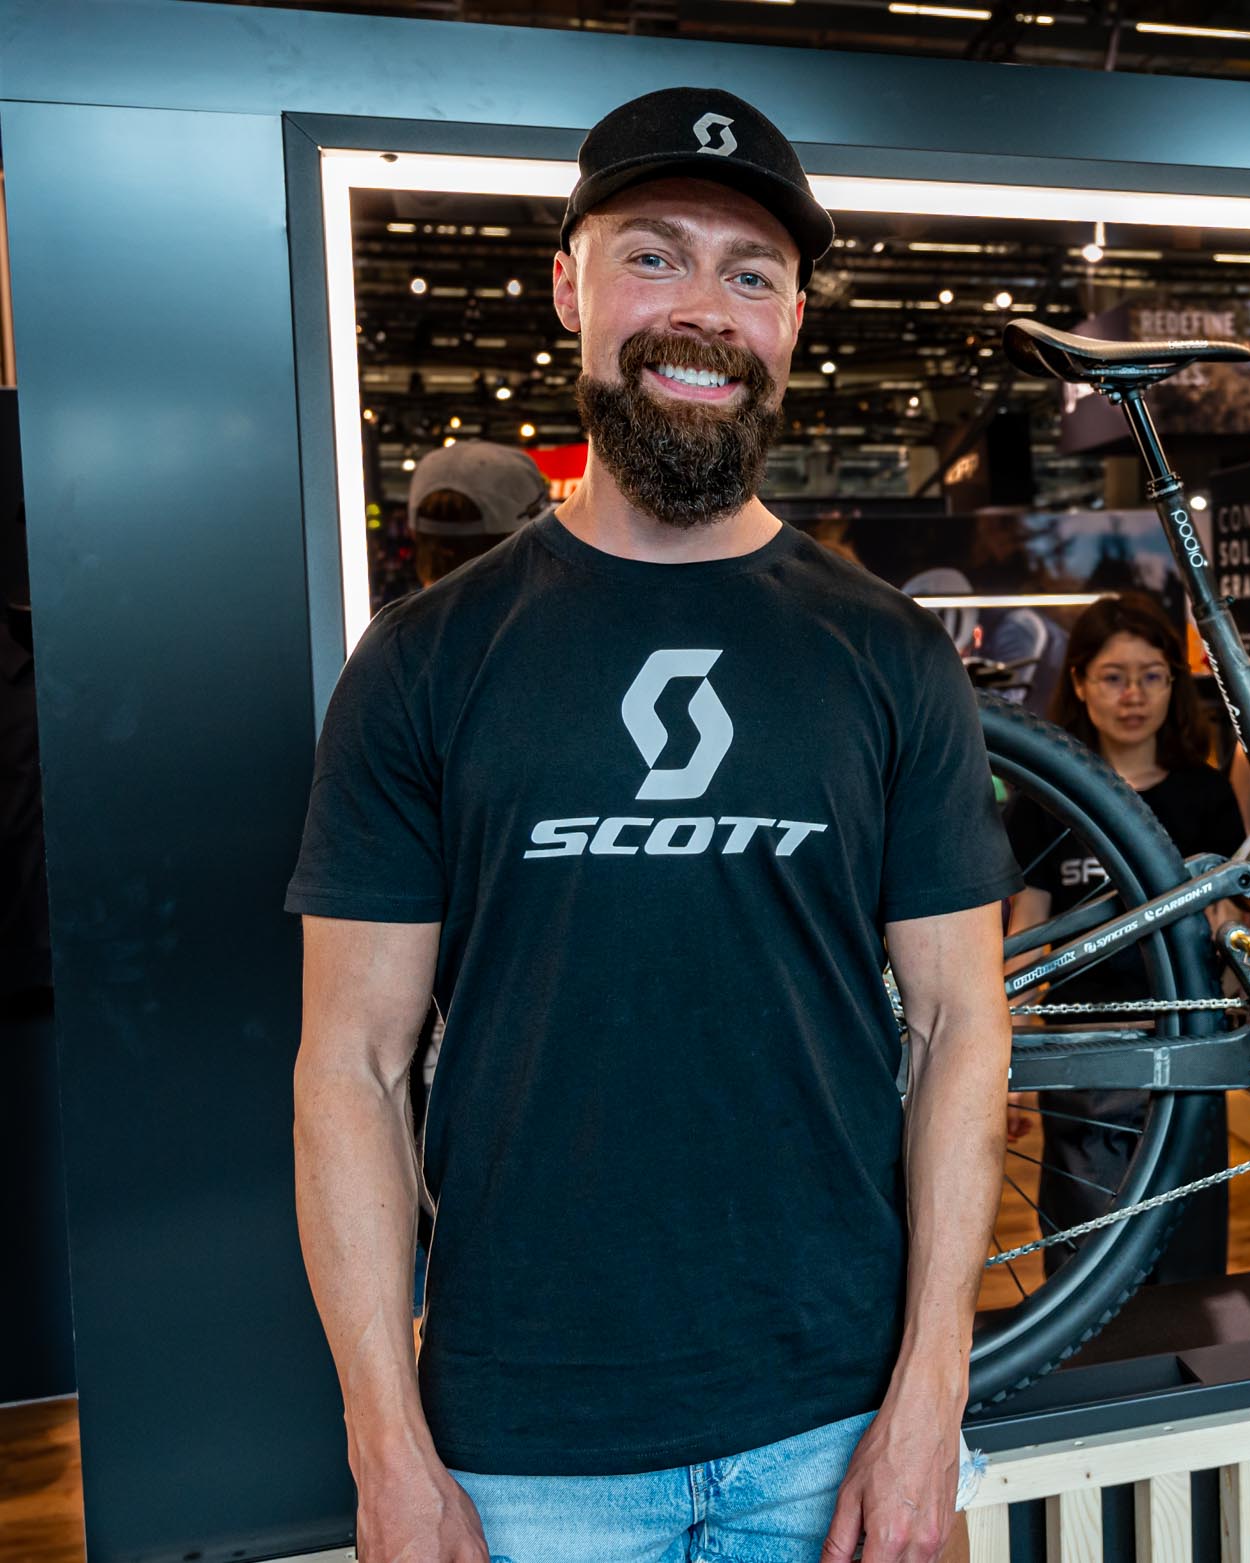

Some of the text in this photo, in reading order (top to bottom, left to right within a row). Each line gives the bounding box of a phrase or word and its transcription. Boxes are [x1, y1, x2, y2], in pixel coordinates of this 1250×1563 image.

[1140, 309, 1236, 335] REDEFINE
[523, 816, 828, 859] SCOTT
[1096, 920, 1139, 946] syncros
[1155, 882, 1213, 917] CARBON-TI
